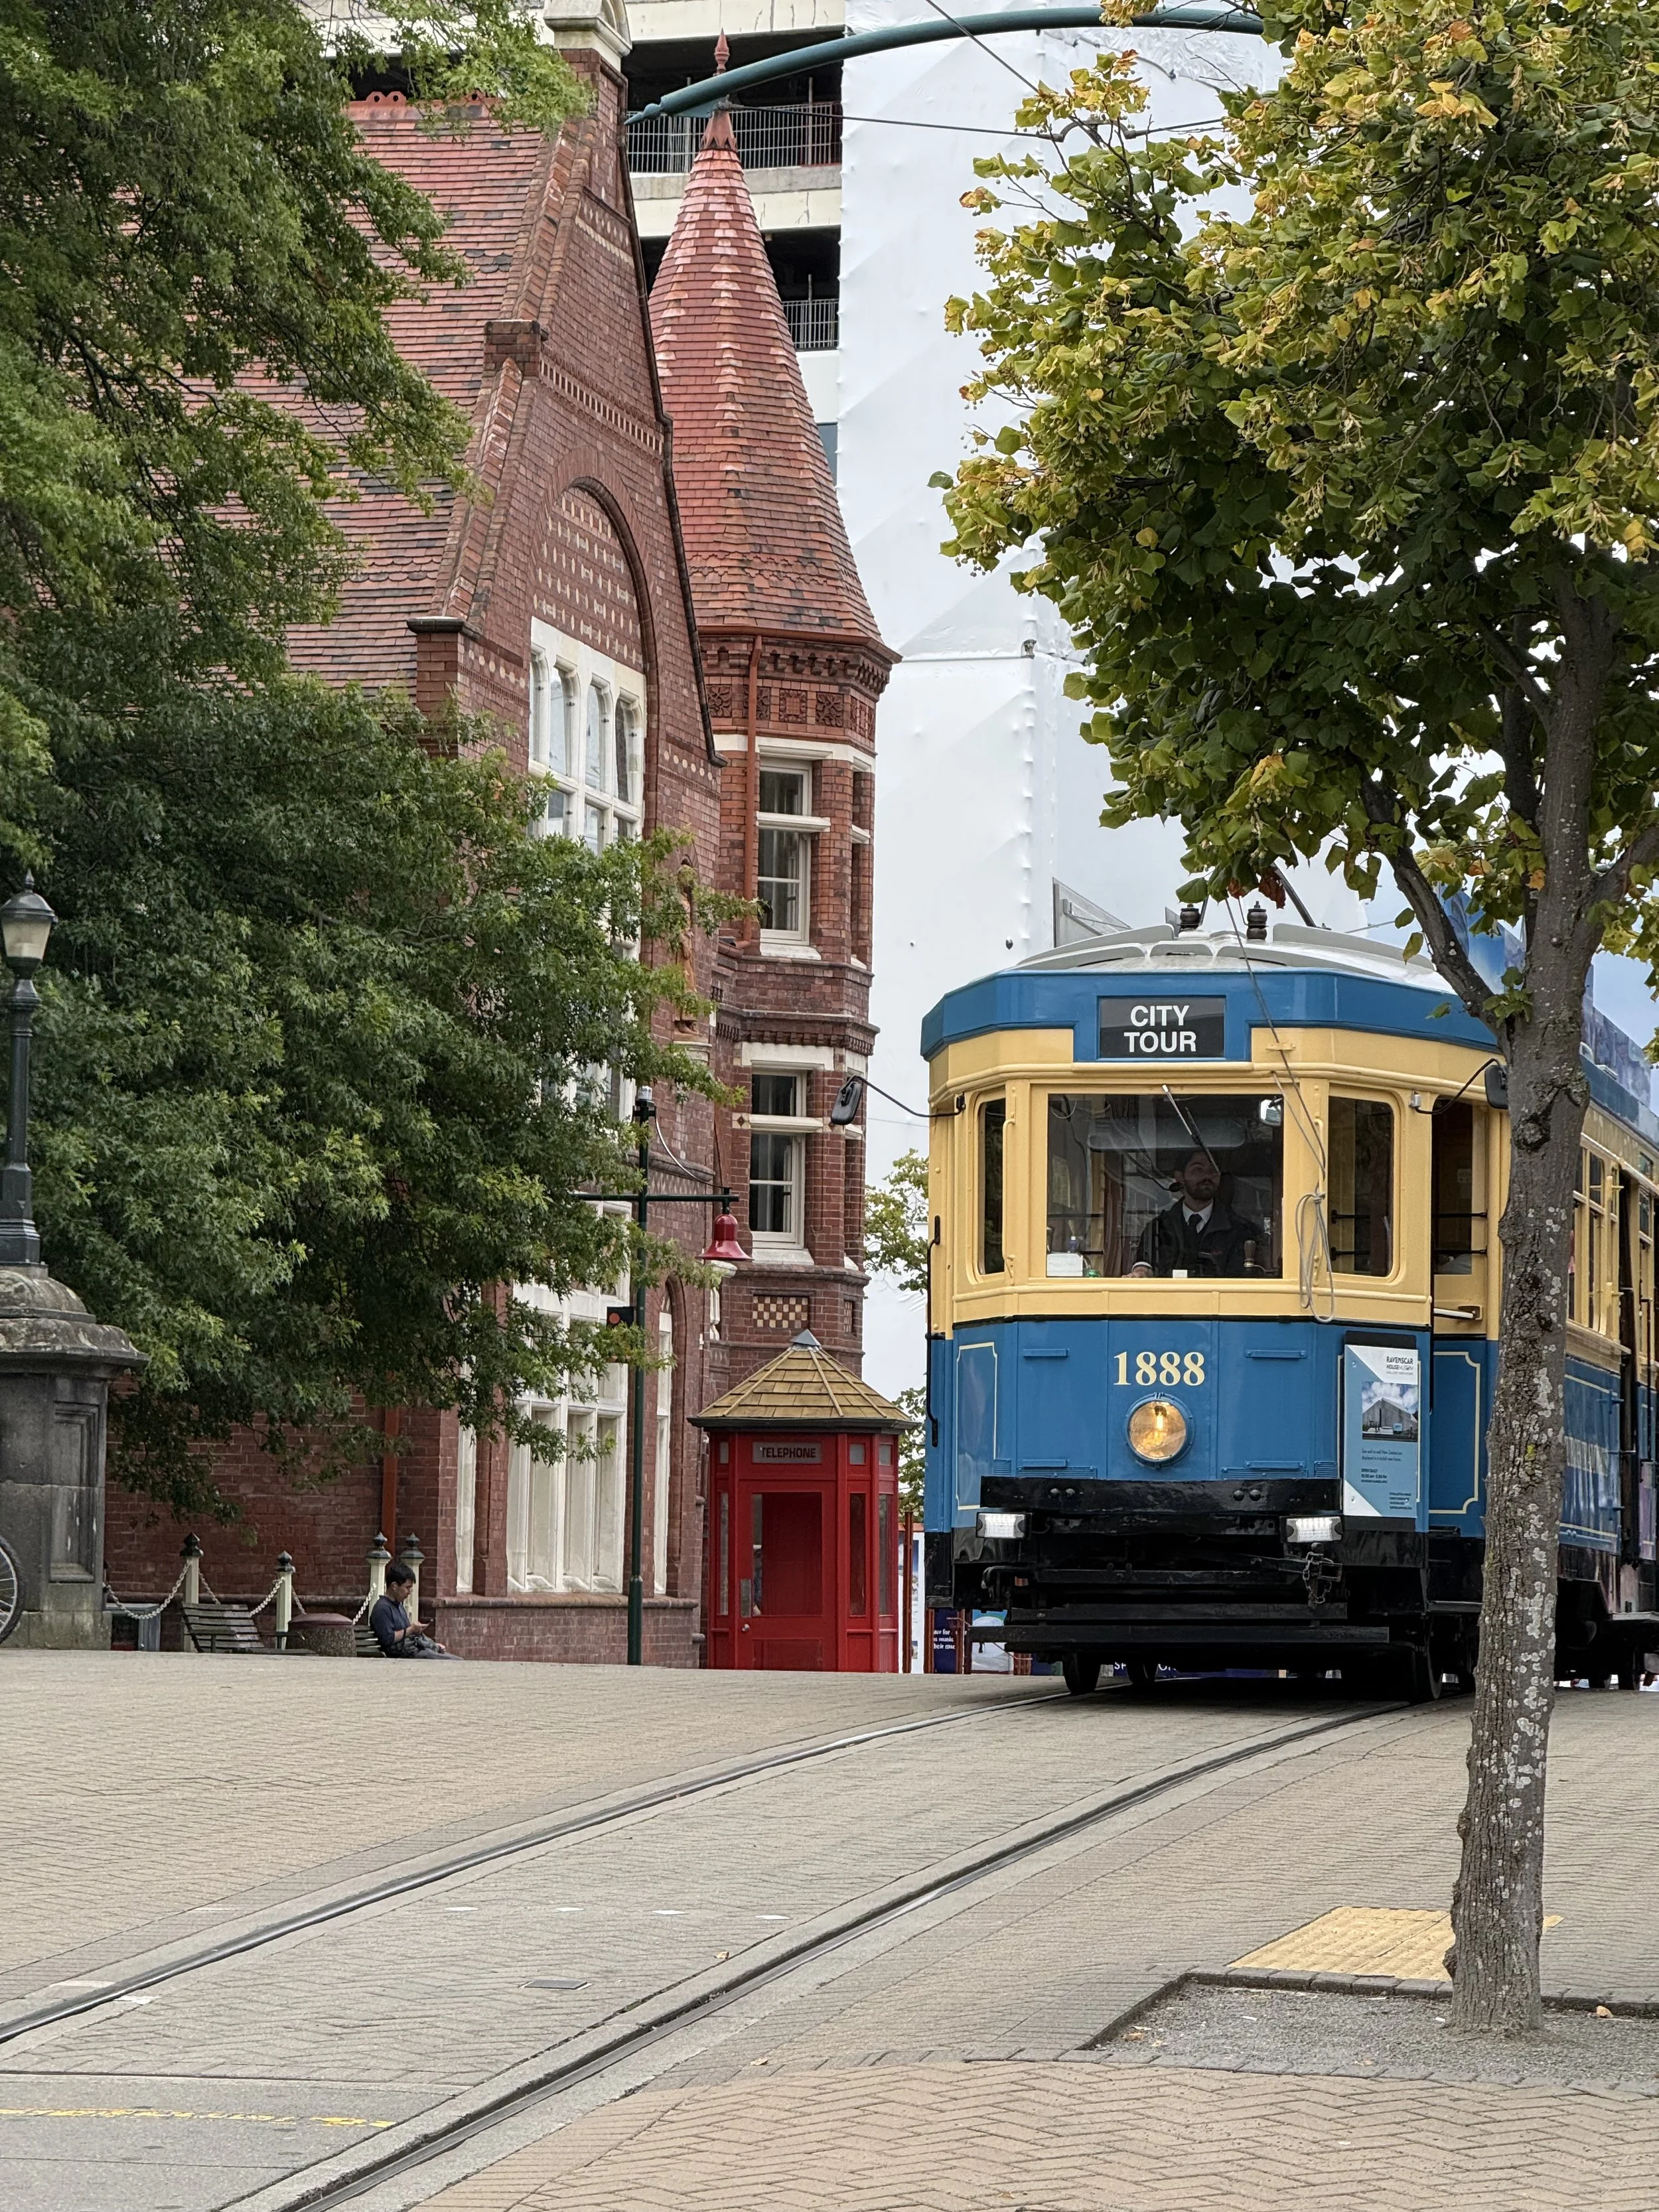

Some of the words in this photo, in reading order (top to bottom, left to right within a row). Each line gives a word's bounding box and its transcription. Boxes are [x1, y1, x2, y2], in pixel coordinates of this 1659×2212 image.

[1130, 1005, 1190, 1027] CITY
[1123, 1031, 1196, 1053] TOUR
[1113, 1351, 1205, 1386] 1888
[761, 1447, 816, 1458] TELEPHONE
